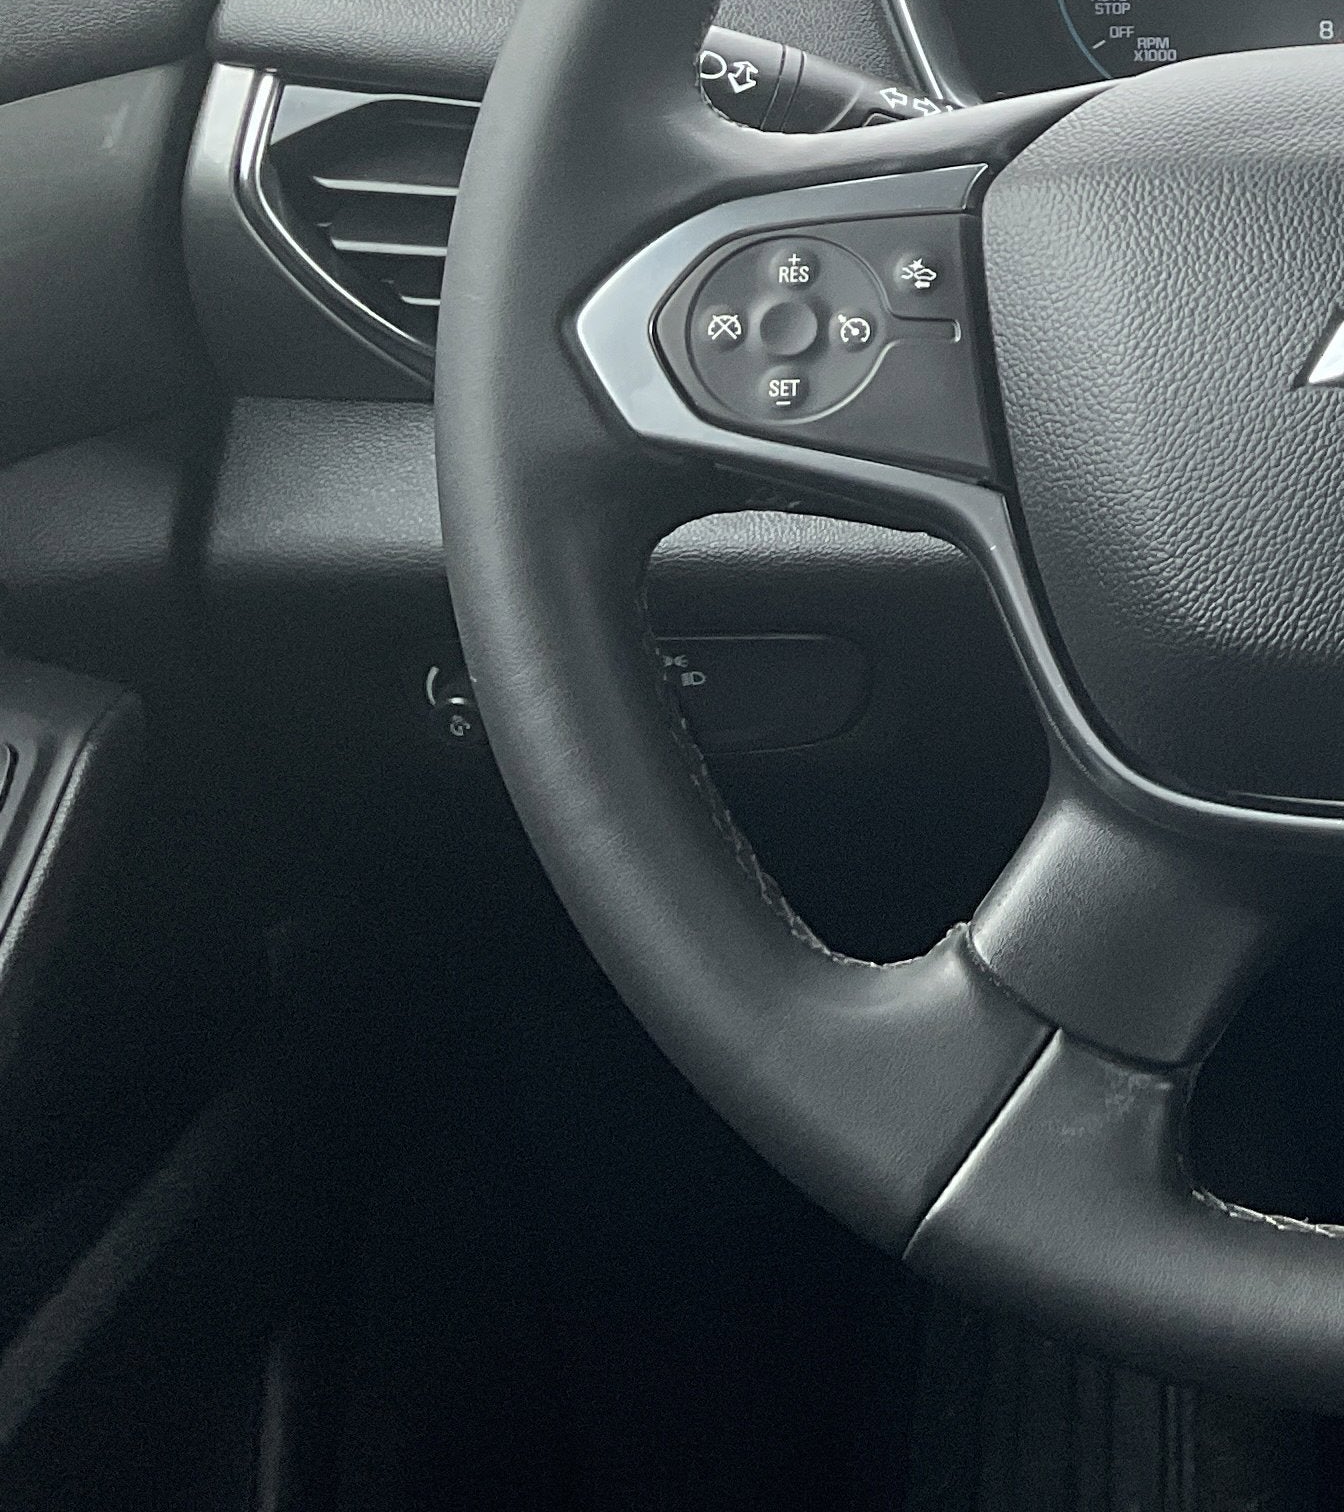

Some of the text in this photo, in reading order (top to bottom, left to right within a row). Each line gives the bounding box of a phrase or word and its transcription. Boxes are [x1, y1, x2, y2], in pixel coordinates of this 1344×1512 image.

[1095, 3, 1131, 16] STOP
[1109, 26, 1135, 39] OFF
[1319, 21, 1334, 40] 8
[1137, 37, 1170, 50] RPM
[1133, 49, 1177, 62] X1000
[779, 266, 809, 283] RES
[768, 379, 800, 397] SET
